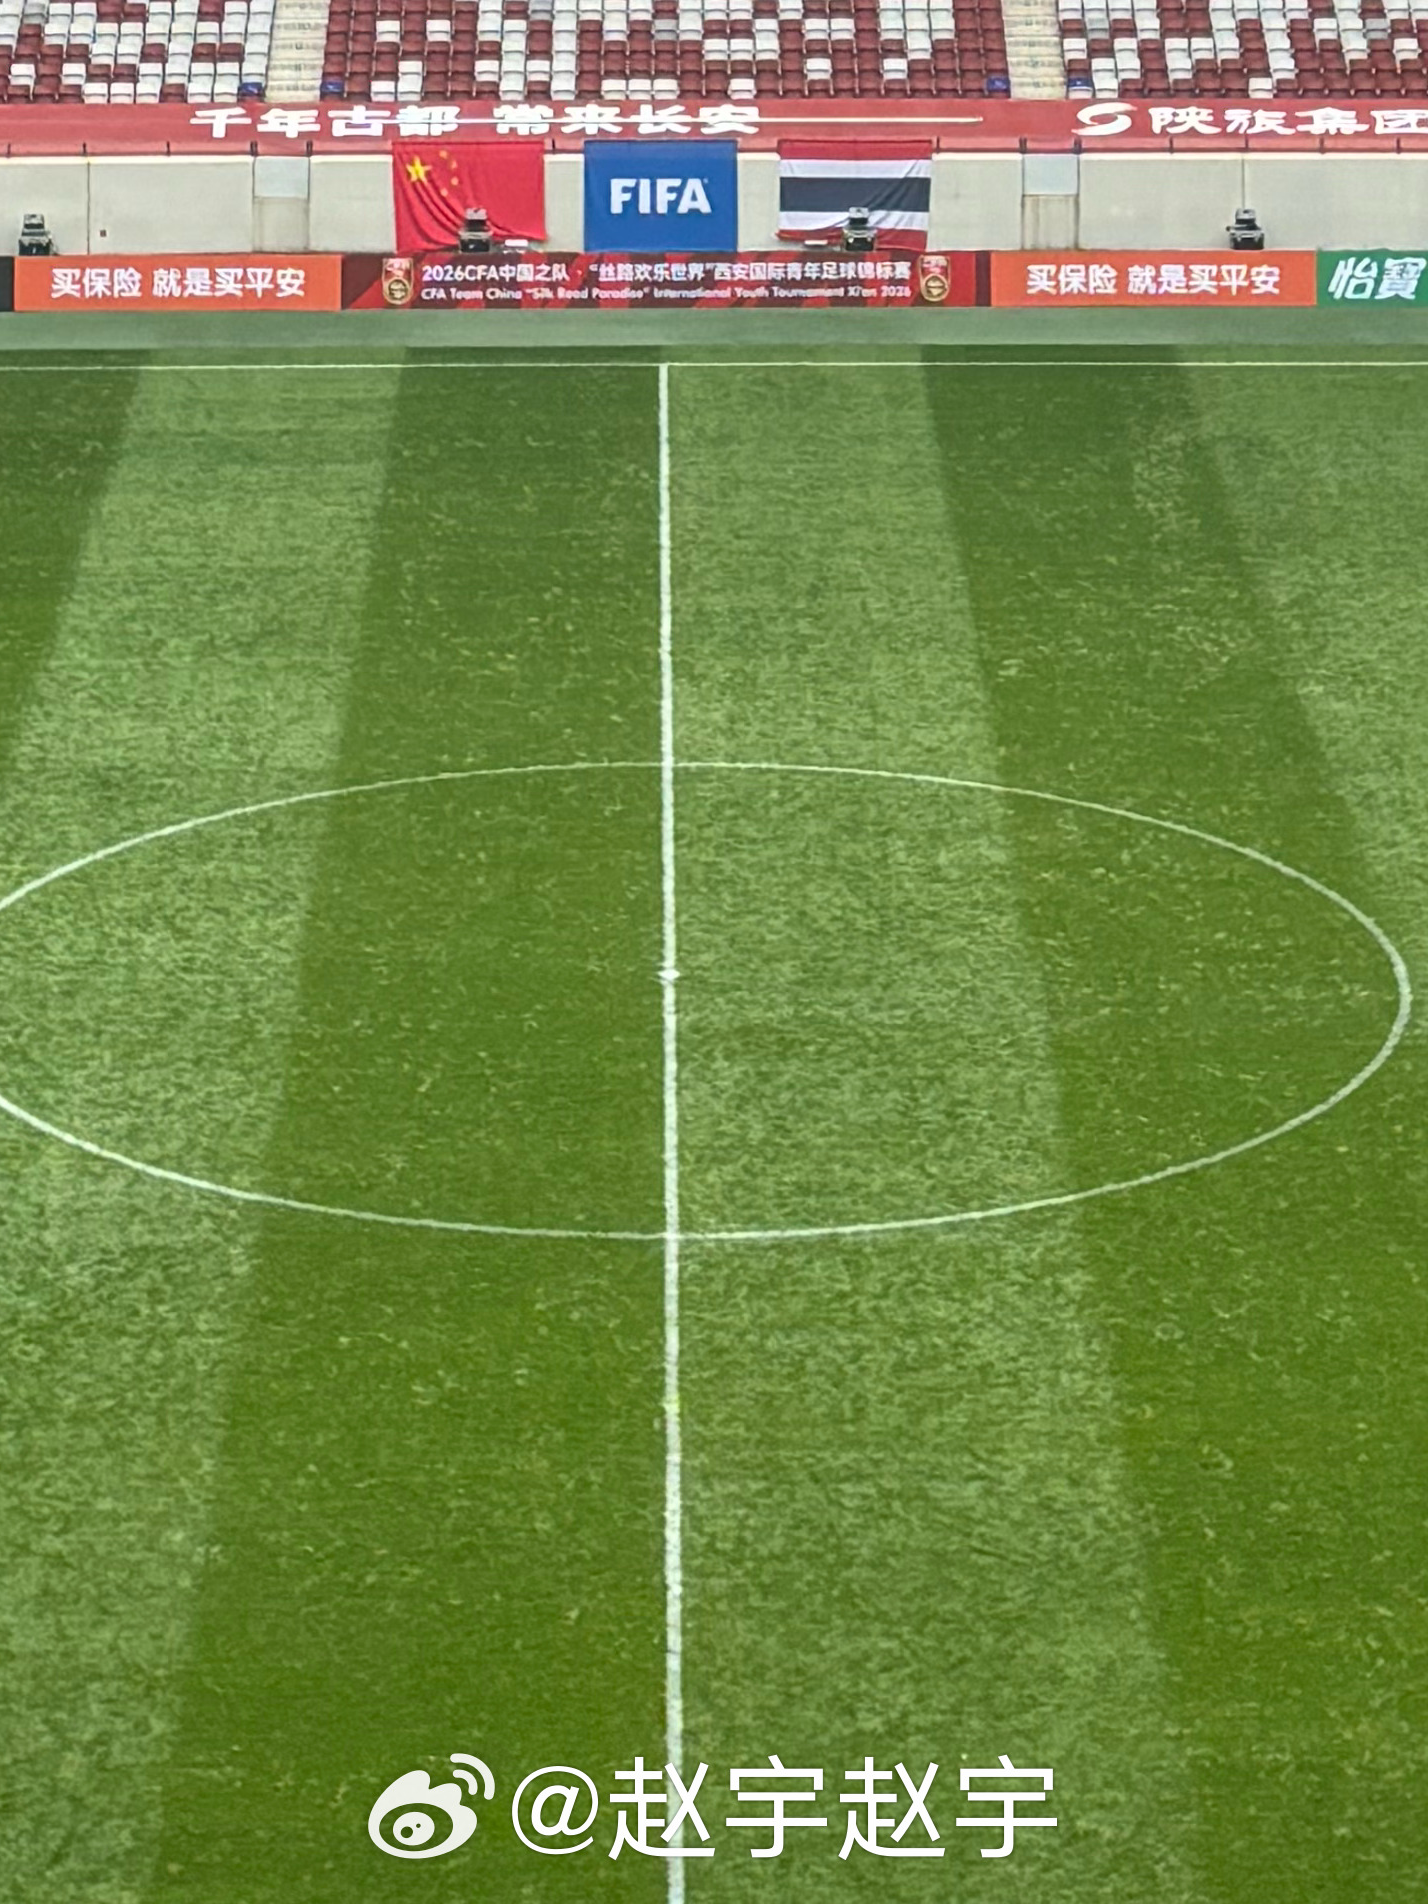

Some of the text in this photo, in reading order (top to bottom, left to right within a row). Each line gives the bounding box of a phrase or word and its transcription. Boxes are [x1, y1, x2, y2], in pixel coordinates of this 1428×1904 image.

[189, 104, 760, 138] 千年古都 常来长安
[610, 177, 713, 214] FIFA
[51, 267, 305, 299] 买保险 就是买平安
[1026, 264, 1281, 296] 买保险 就是买平安
